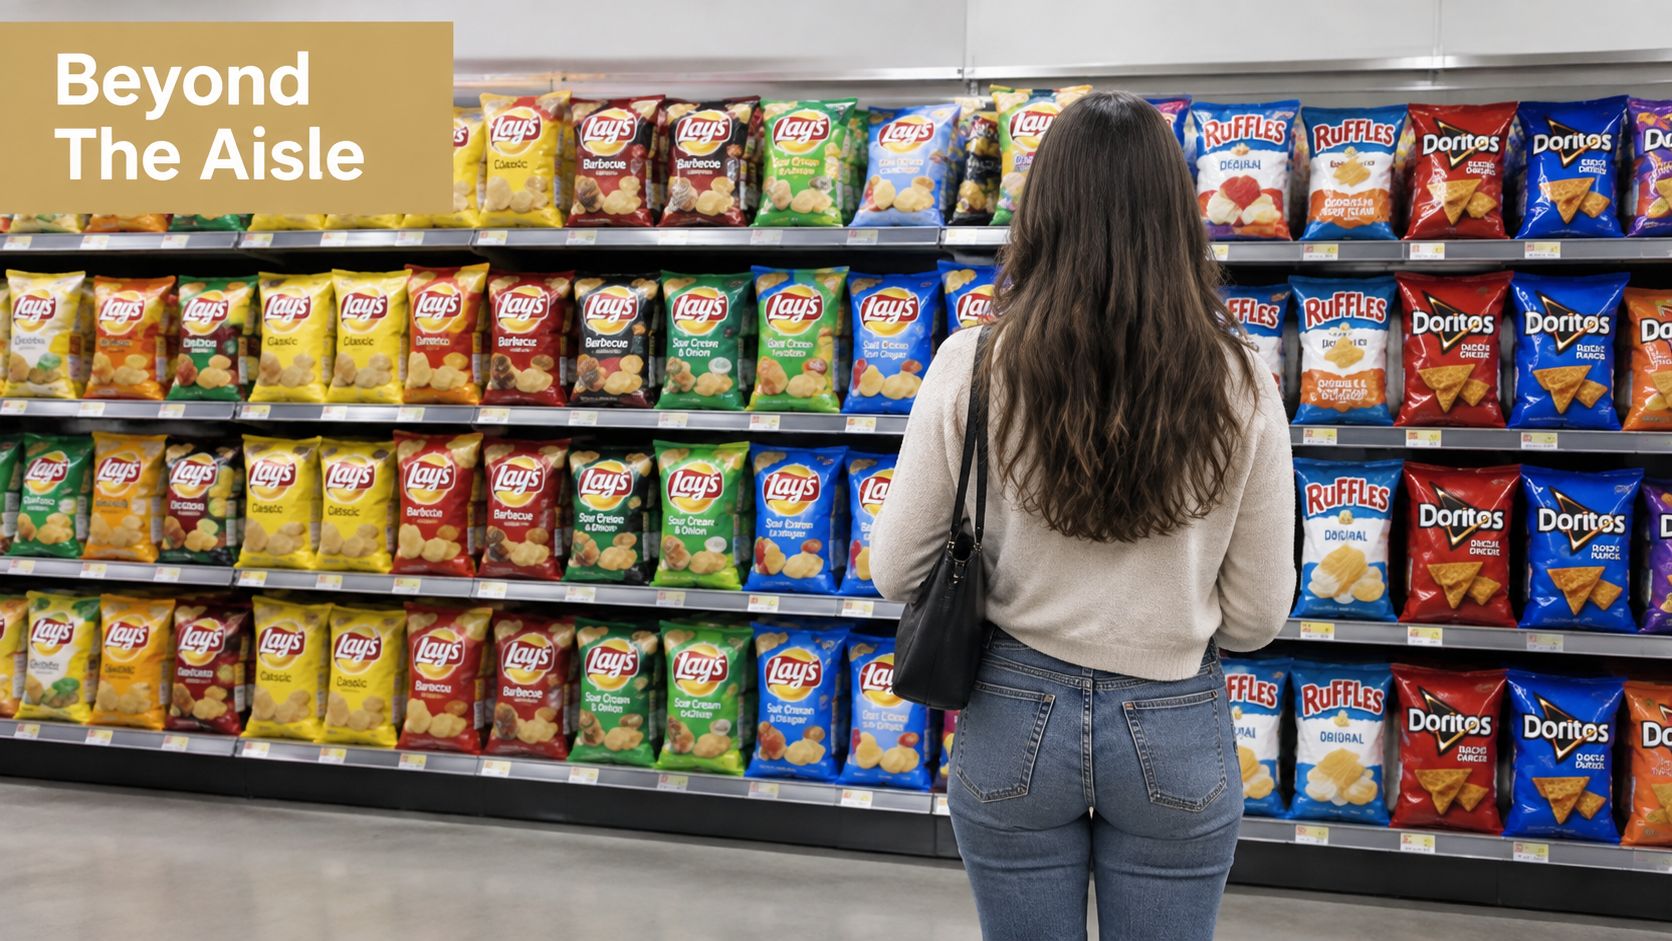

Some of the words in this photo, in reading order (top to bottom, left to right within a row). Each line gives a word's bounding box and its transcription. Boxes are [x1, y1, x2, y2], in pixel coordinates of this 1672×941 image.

[491, 114, 539, 144] Lay's
[584, 114, 632, 144] Lay's
[677, 115, 728, 144] Lay's
[775, 113, 828, 143] Lay's
[880, 118, 932, 144] Lay's
[1013, 113, 1054, 137] Lay
[1423, 134, 1499, 154] Doritos
[1534, 134, 1611, 154] Doritos
[14, 296, 53, 321] Lay's
[101, 296, 142, 323] Lay's
[184, 297, 226, 323] Lay's
[266, 295, 309, 321] Lay's
[342, 294, 385, 321] Lay's
[416, 294, 461, 321] Lay's
[499, 294, 545, 321] Lay's
[587, 296, 635, 322] Lay's
[675, 295, 724, 321] Lay's
[769, 296, 820, 322] Lay's
[864, 296, 916, 323] Lay's
[1413, 312, 1494, 334] Doritos
[1525, 312, 1609, 334] Doritos
[25, 458, 67, 482] Lay's
[99, 458, 140, 483] Lay's
[172, 462, 216, 485] Lay's
[250, 461, 293, 488] Lay's
[327, 462, 373, 489] Lay's
[407, 461, 453, 491] Lay's
[494, 465, 540, 494] Lay's
[581, 468, 630, 498] Lay's
[671, 469, 721, 499] Lay's
[766, 474, 817, 503] Lay's
[1420, 504, 1503, 529] Doritos
[1539, 509, 1625, 533] Doritos
[32, 619, 74, 646] Lay's
[105, 621, 149, 649] Lay's
[180, 626, 223, 654] Lay's
[260, 627, 303, 656] Lay's
[335, 632, 380, 662] Lay's
[416, 637, 463, 667] Lay's
[505, 642, 551, 671] Lay's
[587, 647, 636, 678] Lay's
[675, 651, 725, 683] Lay's
[768, 658, 819, 688] Lay's
[1227, 675, 1277, 708] FFLES
[1409, 709, 1491, 734] Doritos
[1524, 715, 1608, 742] Doritos
